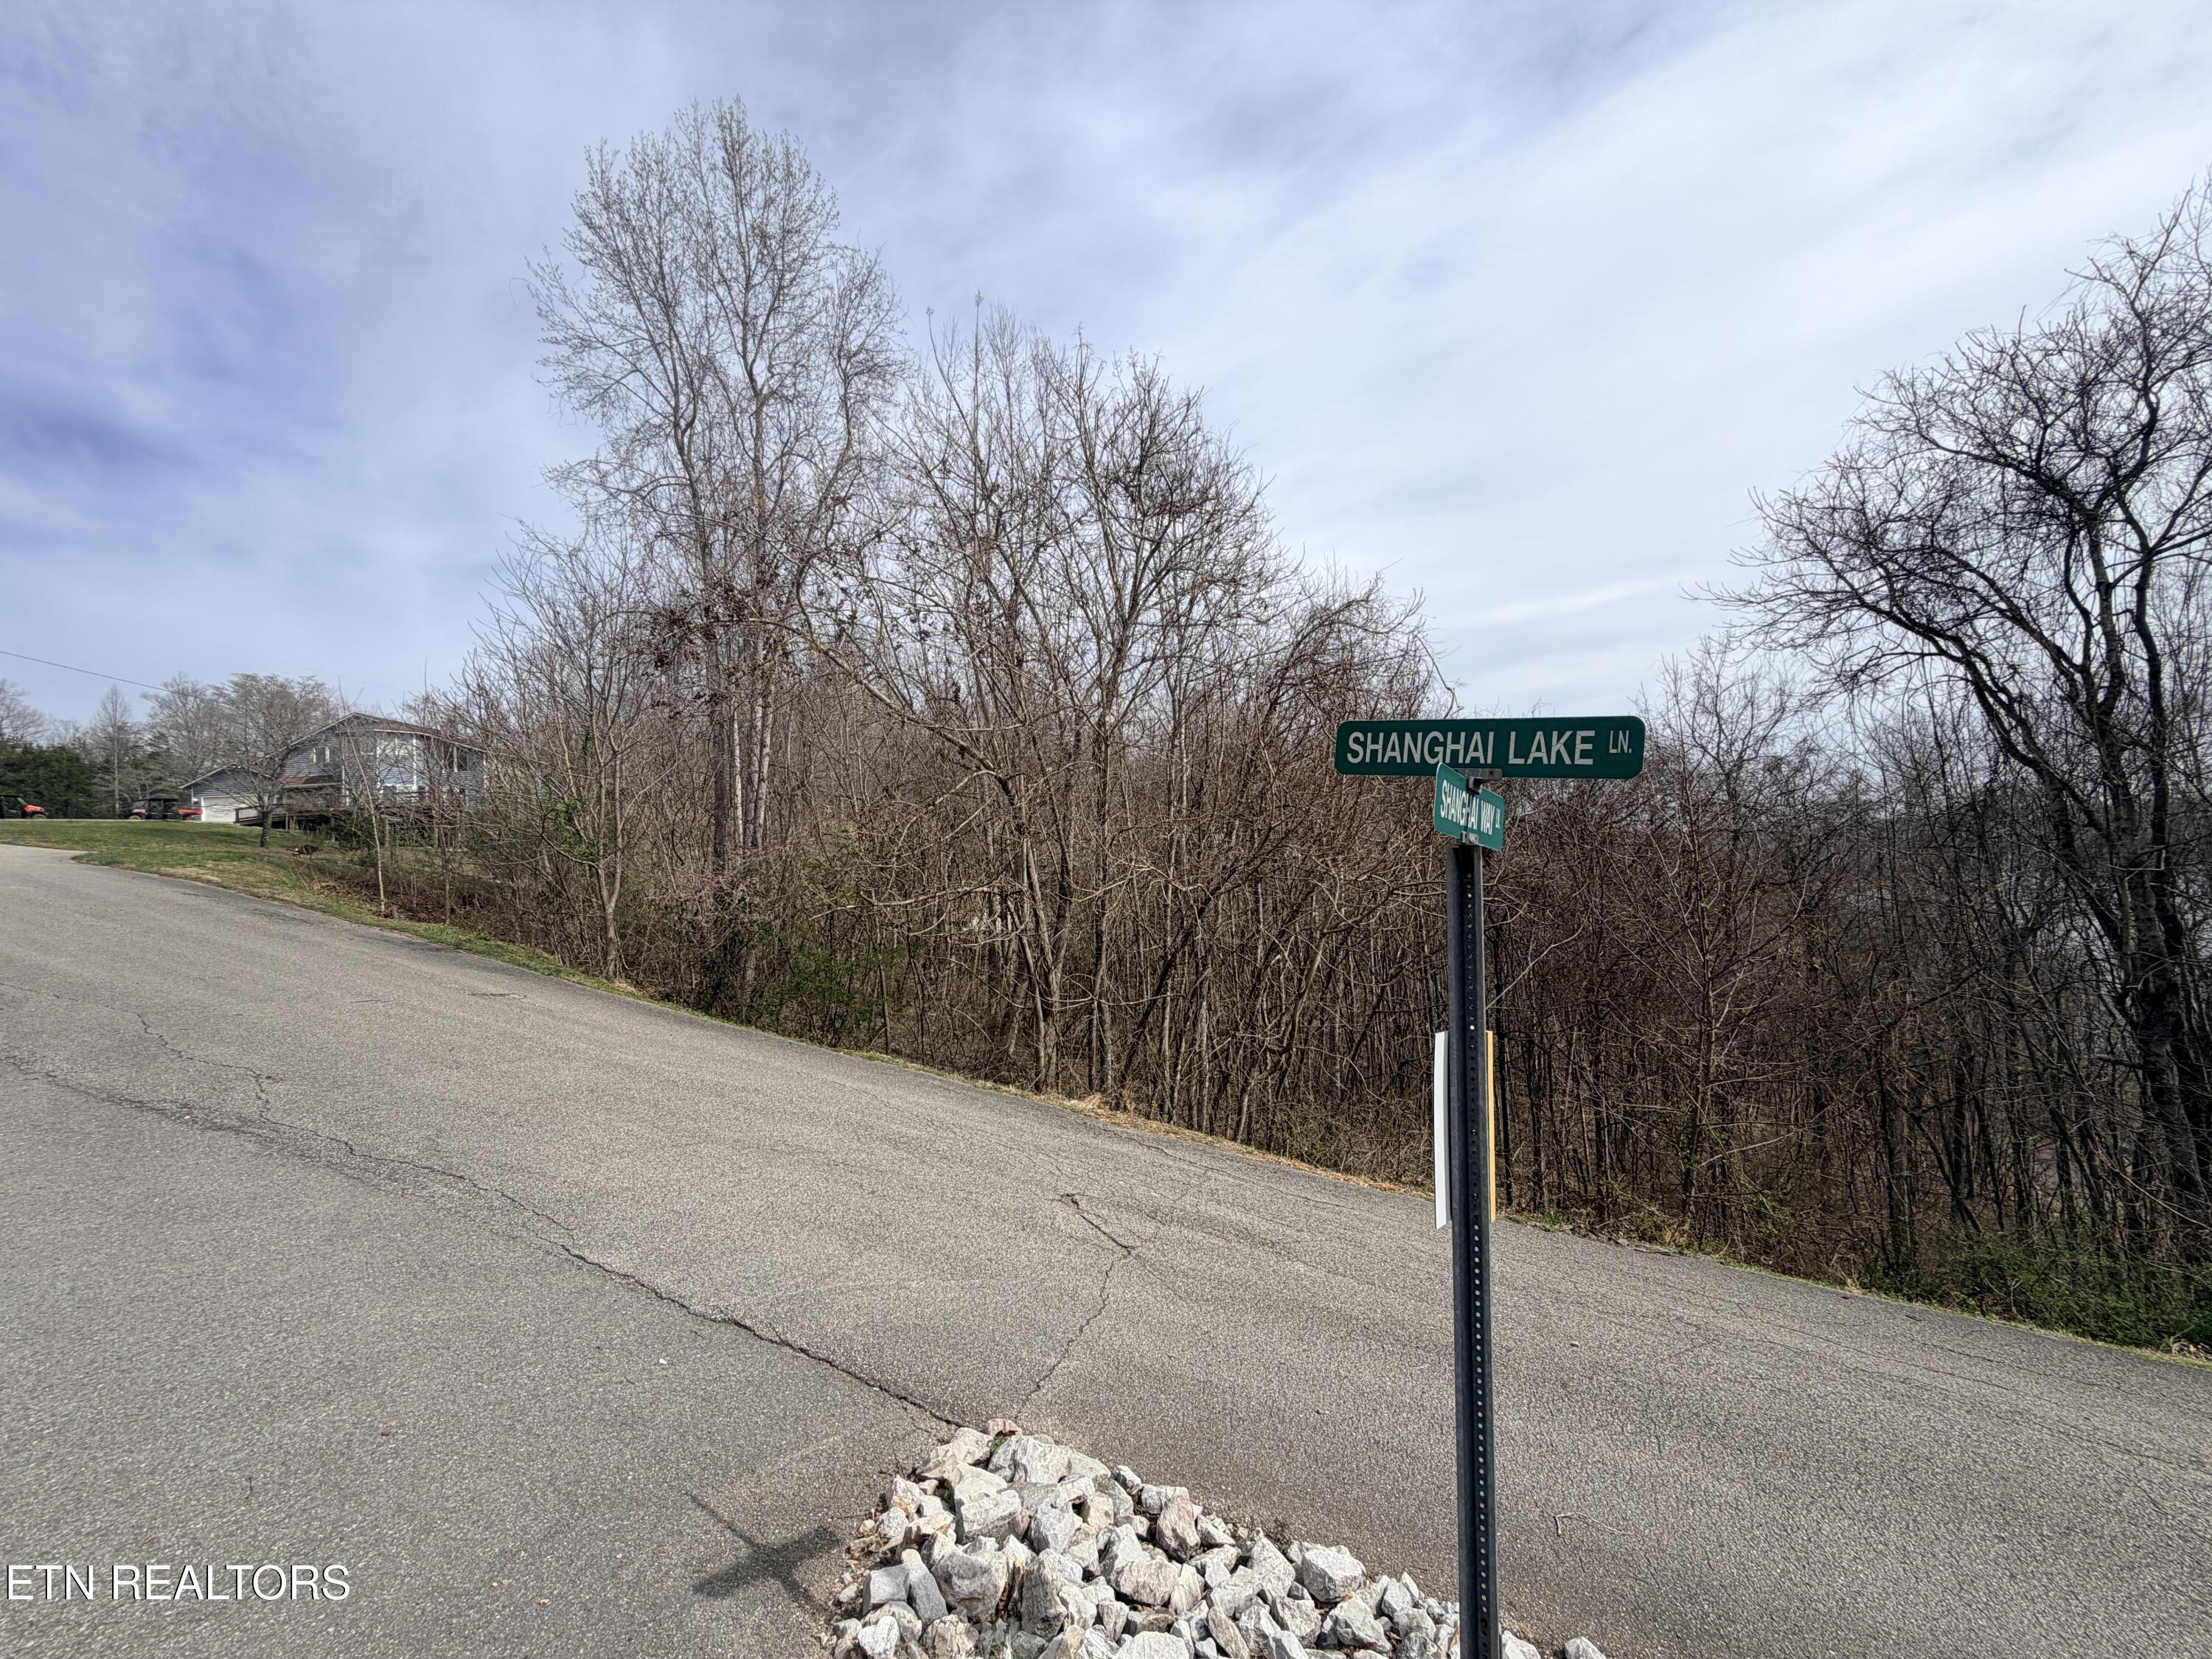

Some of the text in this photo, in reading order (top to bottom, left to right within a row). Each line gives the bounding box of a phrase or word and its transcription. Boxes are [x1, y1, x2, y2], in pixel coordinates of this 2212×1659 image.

[1347, 731, 1494, 765] SHANGHAI
[1508, 730, 1596, 765] LAKE
[1441, 779, 1479, 830] SHANGHAI
[1481, 800, 1495, 835] WAY
